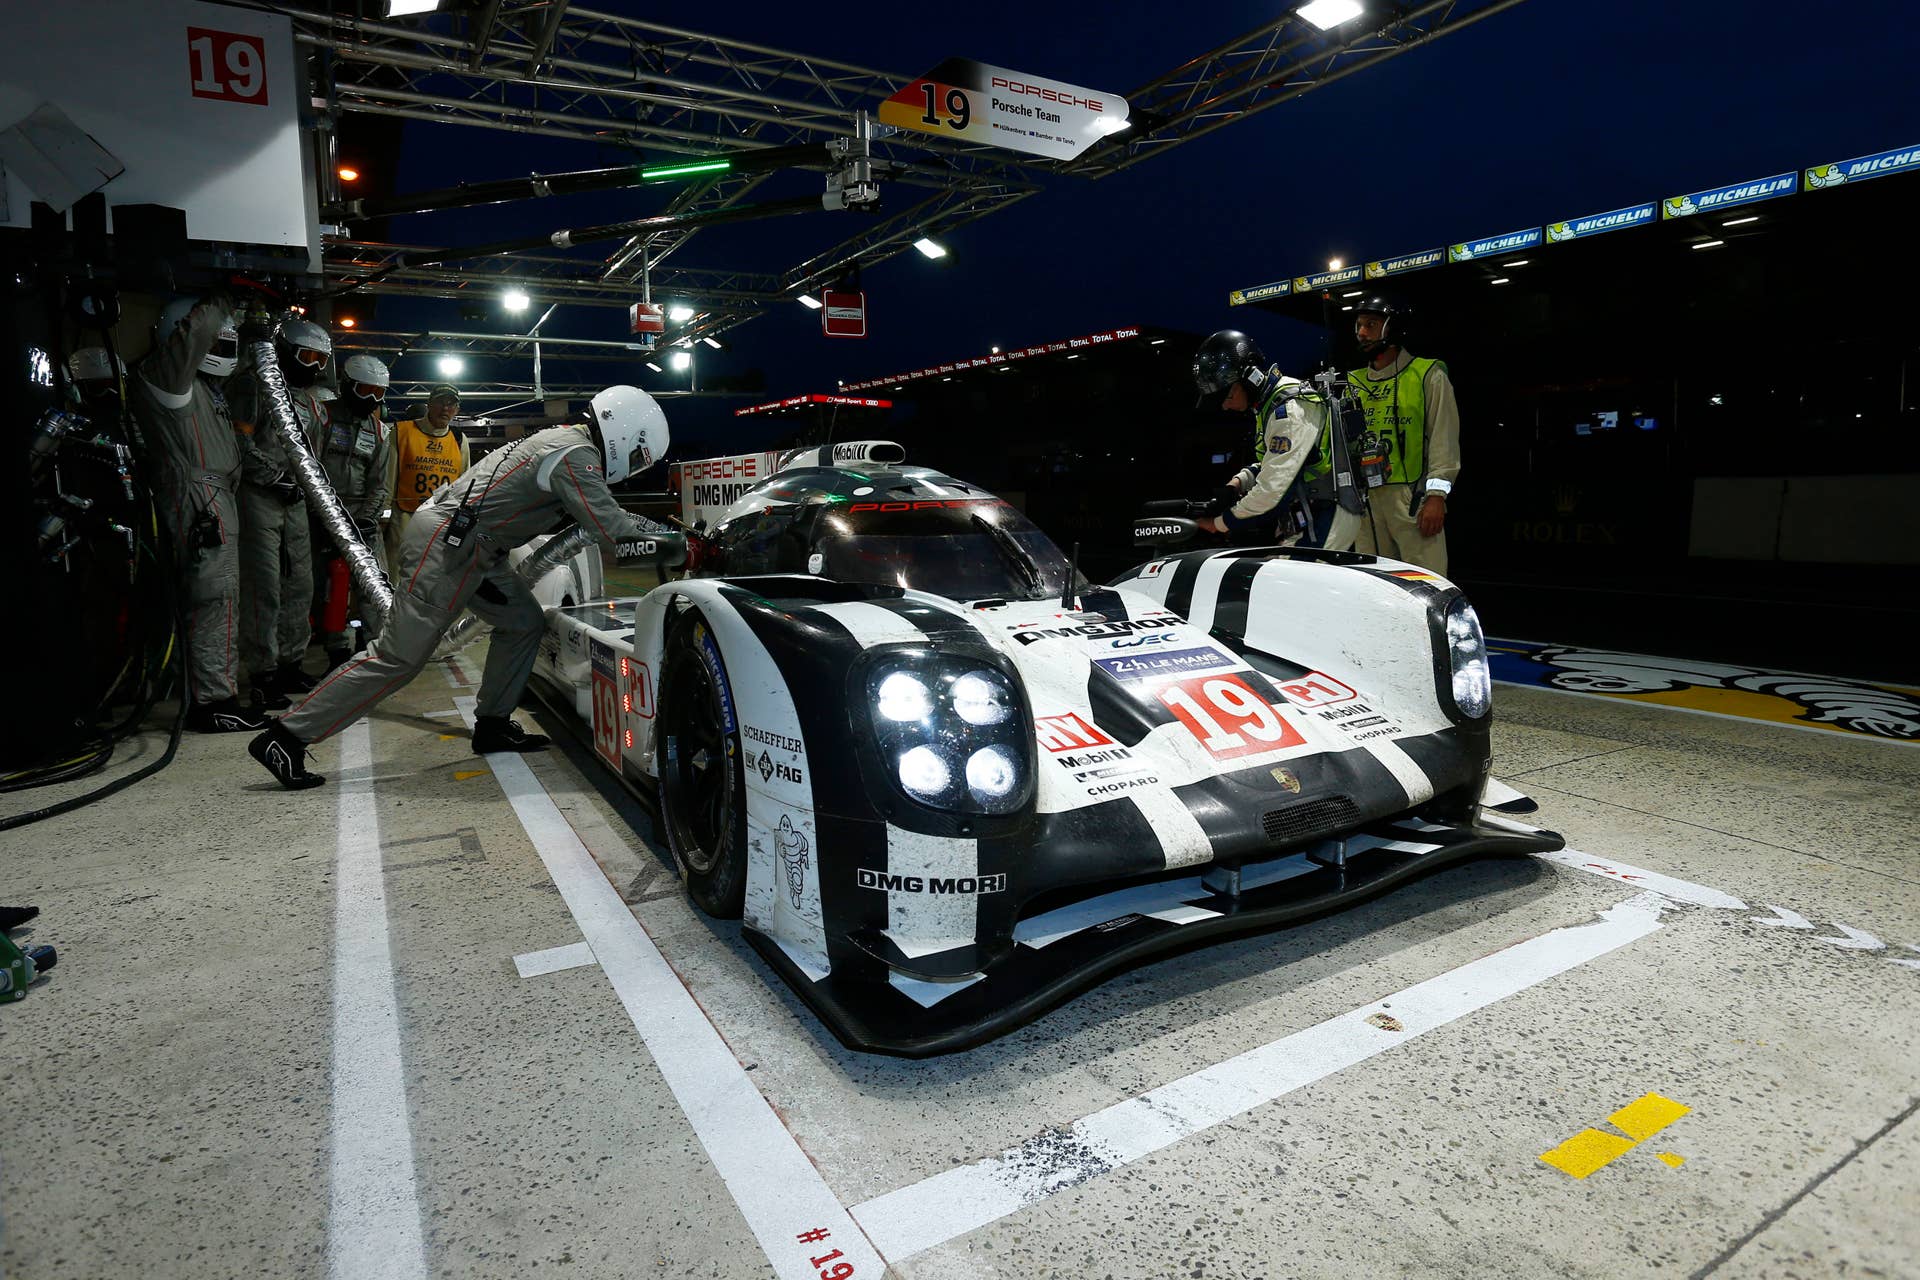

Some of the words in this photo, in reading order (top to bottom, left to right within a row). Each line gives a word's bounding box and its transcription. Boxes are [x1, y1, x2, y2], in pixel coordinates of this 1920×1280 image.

[191, 36, 263, 98] 19
[992, 77, 1102, 112] PORSCHE
[921, 83, 970, 130] 19
[992, 98, 1033, 117] Porsche
[1035, 108, 1061, 123] Team
[1700, 177, 1793, 205] MICHELIN
[1575, 207, 1654, 232] MICHELIN
[1473, 231, 1539, 253] MICHELIN
[1386, 252, 1442, 271] MICHELIN
[1311, 269, 1360, 285] MICHELIN
[1246, 283, 1288, 299] MICHELIN
[971, 359, 987, 367] TOTAL
[989, 355, 1006, 363] TOTAL
[1008, 352, 1025, 360] TOTAL
[1027, 348, 1046, 356] TOTAL
[1069, 339, 1090, 348] TOTAL
[1091, 334, 1113, 343] TOTAL
[1116, 329, 1139, 339] TOTAL
[416, 456, 453, 467] MARSHAL
[684, 459, 756, 480] PORSCHE
[693, 484, 720, 506] DMG
[1135, 525, 1181, 537] CHOPARD
[1012, 624, 1100, 646] DMG
[1111, 633, 1180, 648] WEC
[1110, 659, 1149, 673] 24h
[1151, 660, 1172, 669] LE
[1174, 653, 1220, 667] MANS
[630, 668, 646, 709] P1
[1281, 681, 1340, 702] P1
[595, 679, 617, 756] 19
[1160, 679, 1283, 752] 19
[1318, 704, 1358, 721] Mobil
[743, 724, 803, 753] SCHAEFFLER
[1353, 726, 1402, 741] CHOPARD
[1057, 750, 1113, 769] Mobil
[775, 763, 802, 784] FAG
[1087, 776, 1158, 796] CHOPARD
[859, 870, 924, 893] DMG
[929, 874, 1004, 894] MORI
